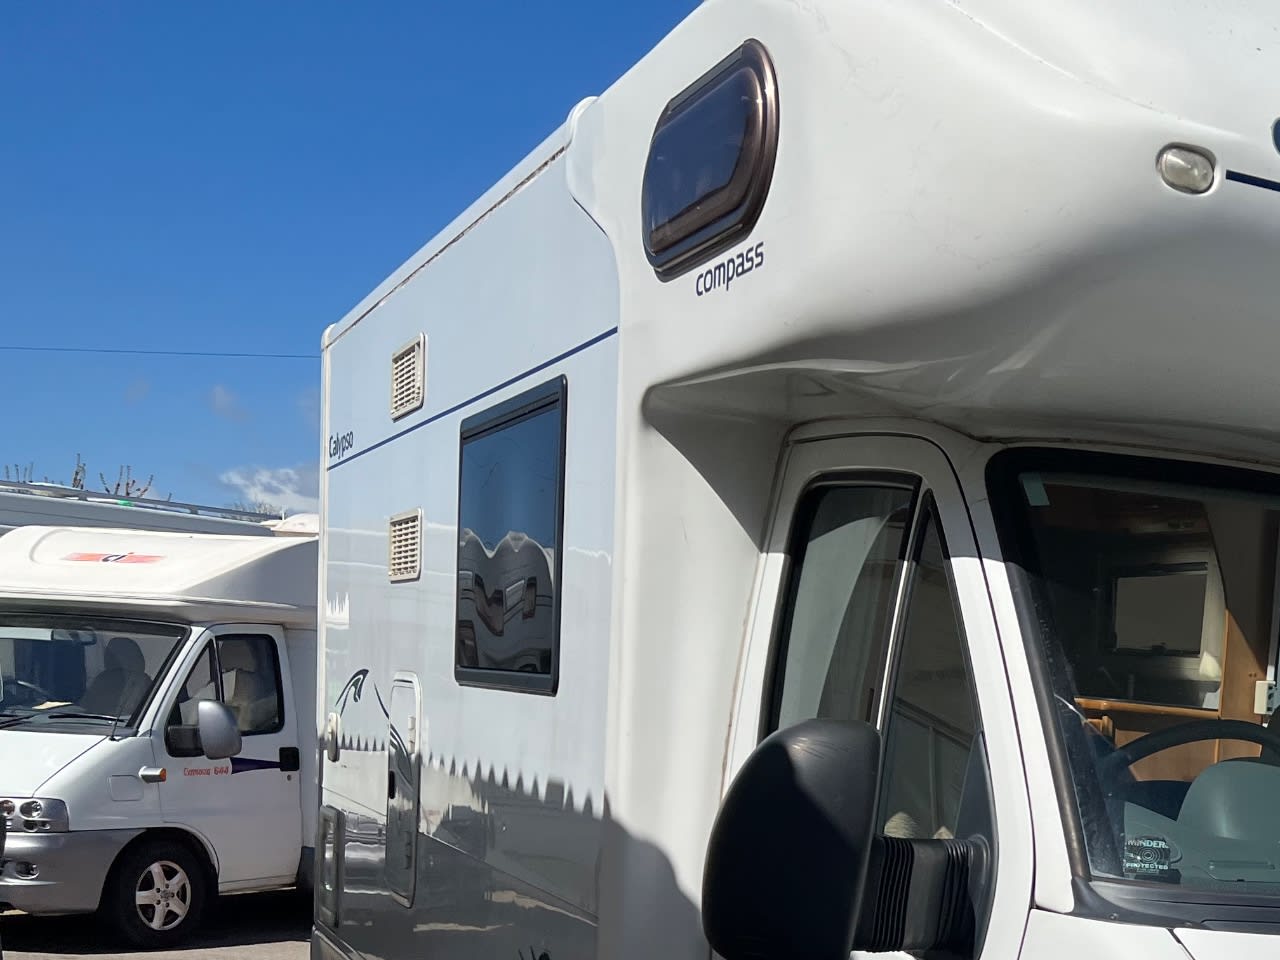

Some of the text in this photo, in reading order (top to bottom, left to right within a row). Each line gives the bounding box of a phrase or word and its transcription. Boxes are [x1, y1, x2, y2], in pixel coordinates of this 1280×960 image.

[696, 241, 764, 297] compass
[328, 430, 354, 460] Calypso
[1125, 862, 1169, 870] PROTECTED
